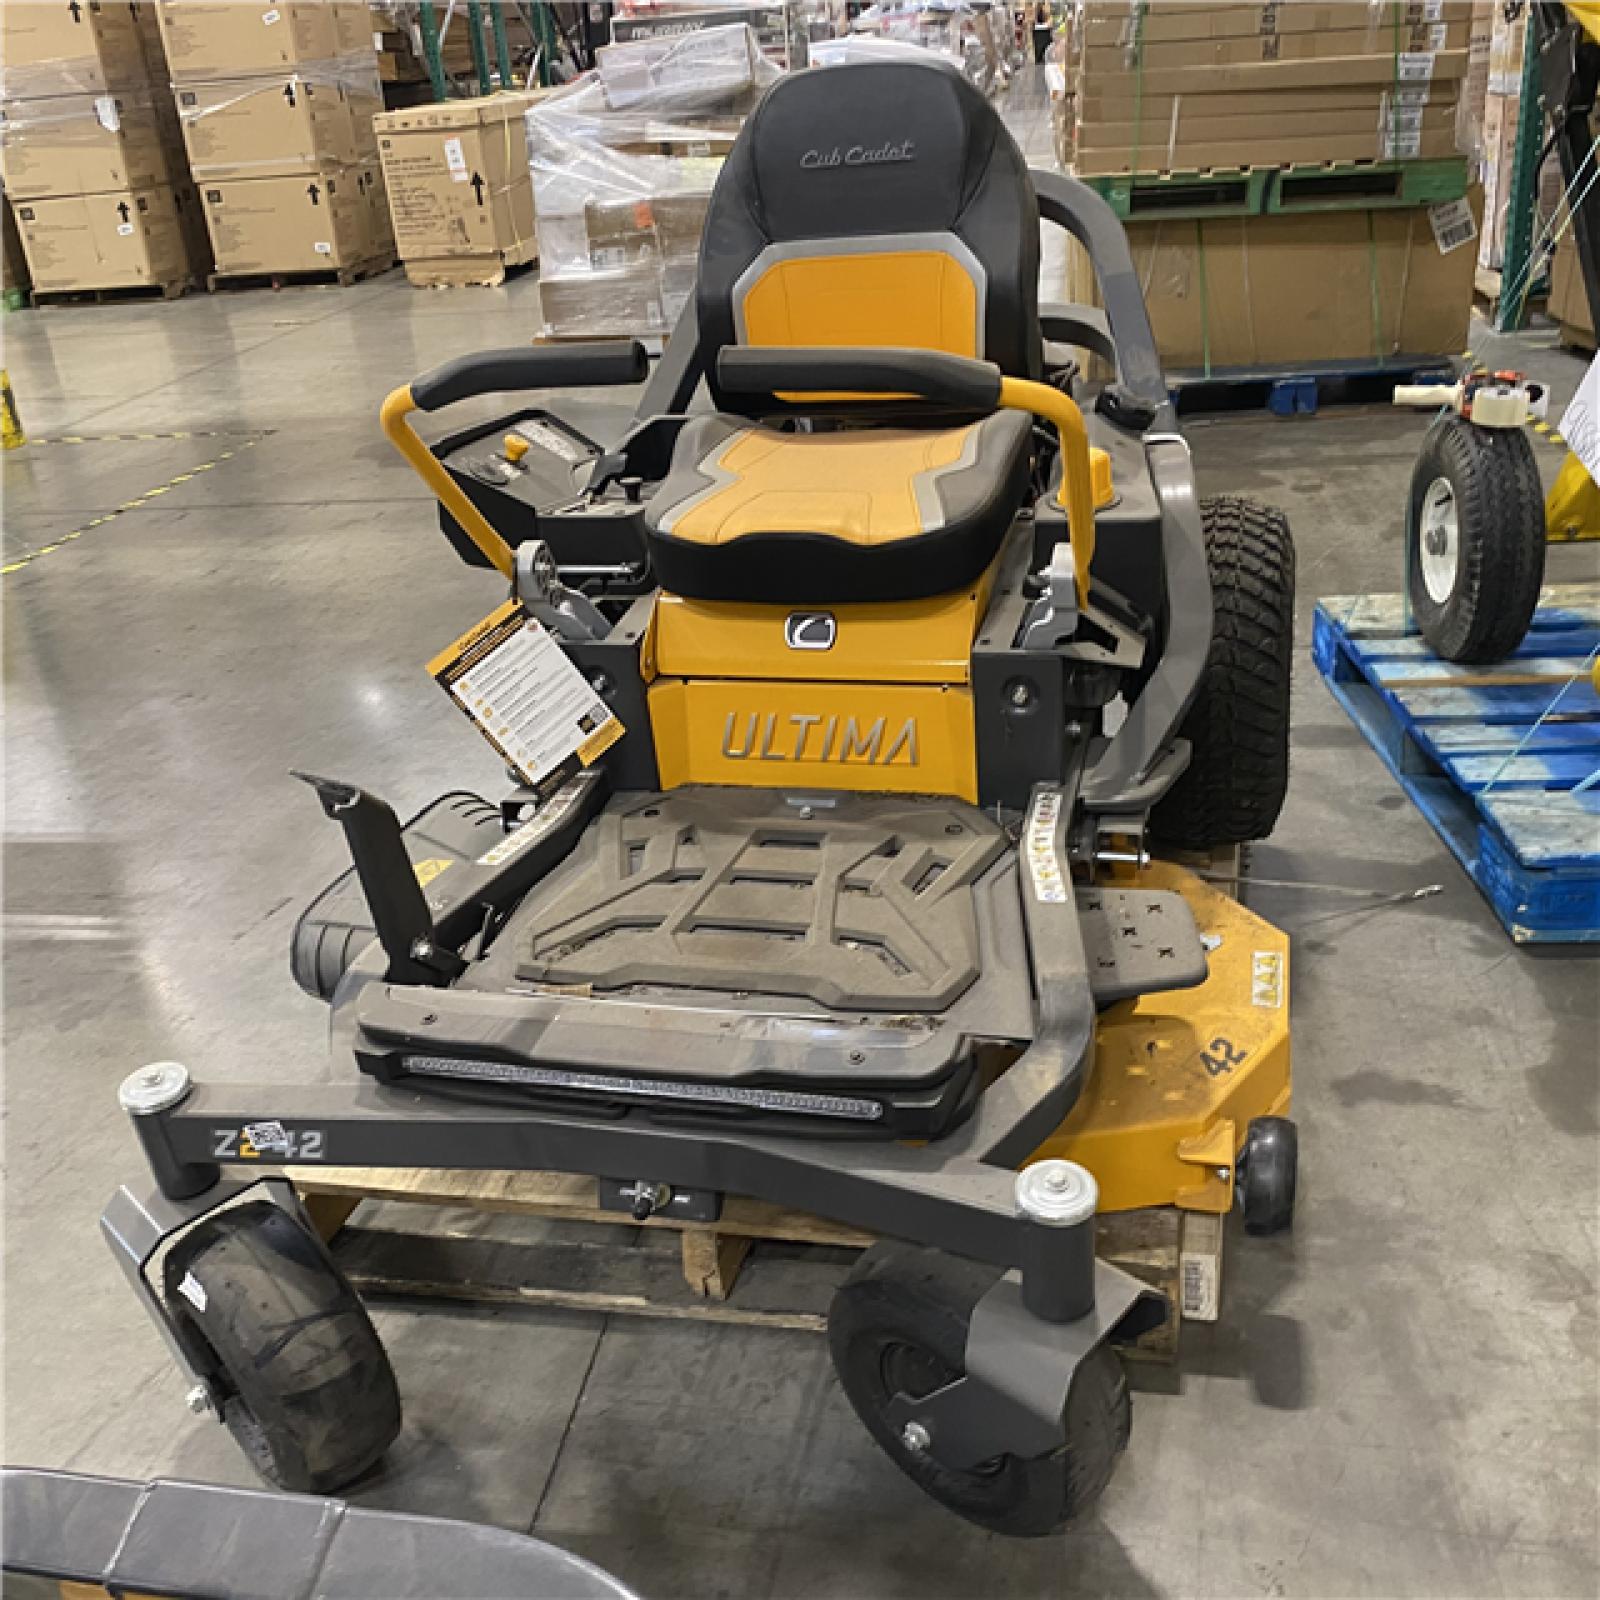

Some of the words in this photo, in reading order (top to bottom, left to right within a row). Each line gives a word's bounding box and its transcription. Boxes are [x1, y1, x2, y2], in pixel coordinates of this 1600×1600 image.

[800, 147, 841, 168] Cub
[845, 139, 915, 165] Cadet
[721, 711, 919, 768] ULTIMA
[1200, 1037, 1248, 1076] 42
